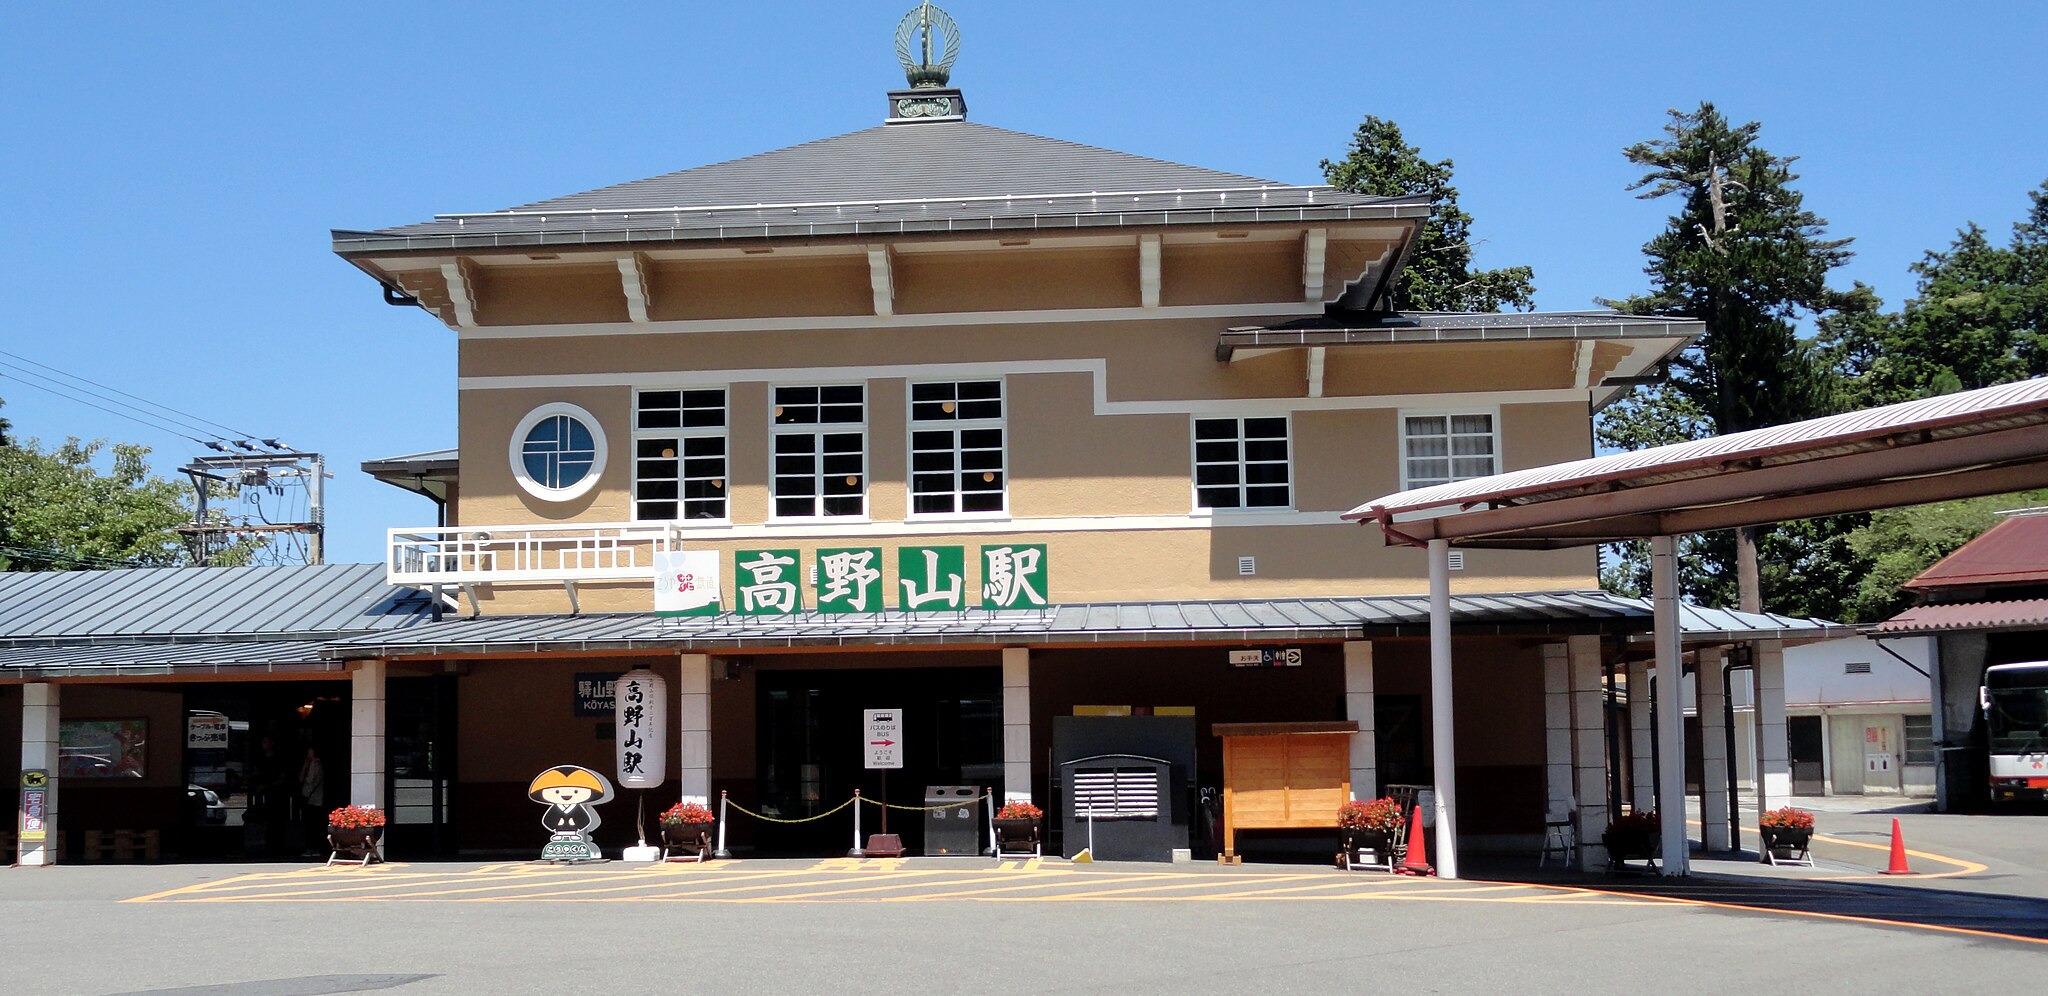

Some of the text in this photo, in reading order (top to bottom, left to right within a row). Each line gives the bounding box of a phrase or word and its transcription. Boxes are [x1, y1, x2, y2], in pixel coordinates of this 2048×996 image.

[740, 547, 1046, 612] 高野山駅
[623, 680, 644, 774] 高野山駅
[27, 793, 42, 829] 宅急便
[547, 845, 587, 854] こうやくん
